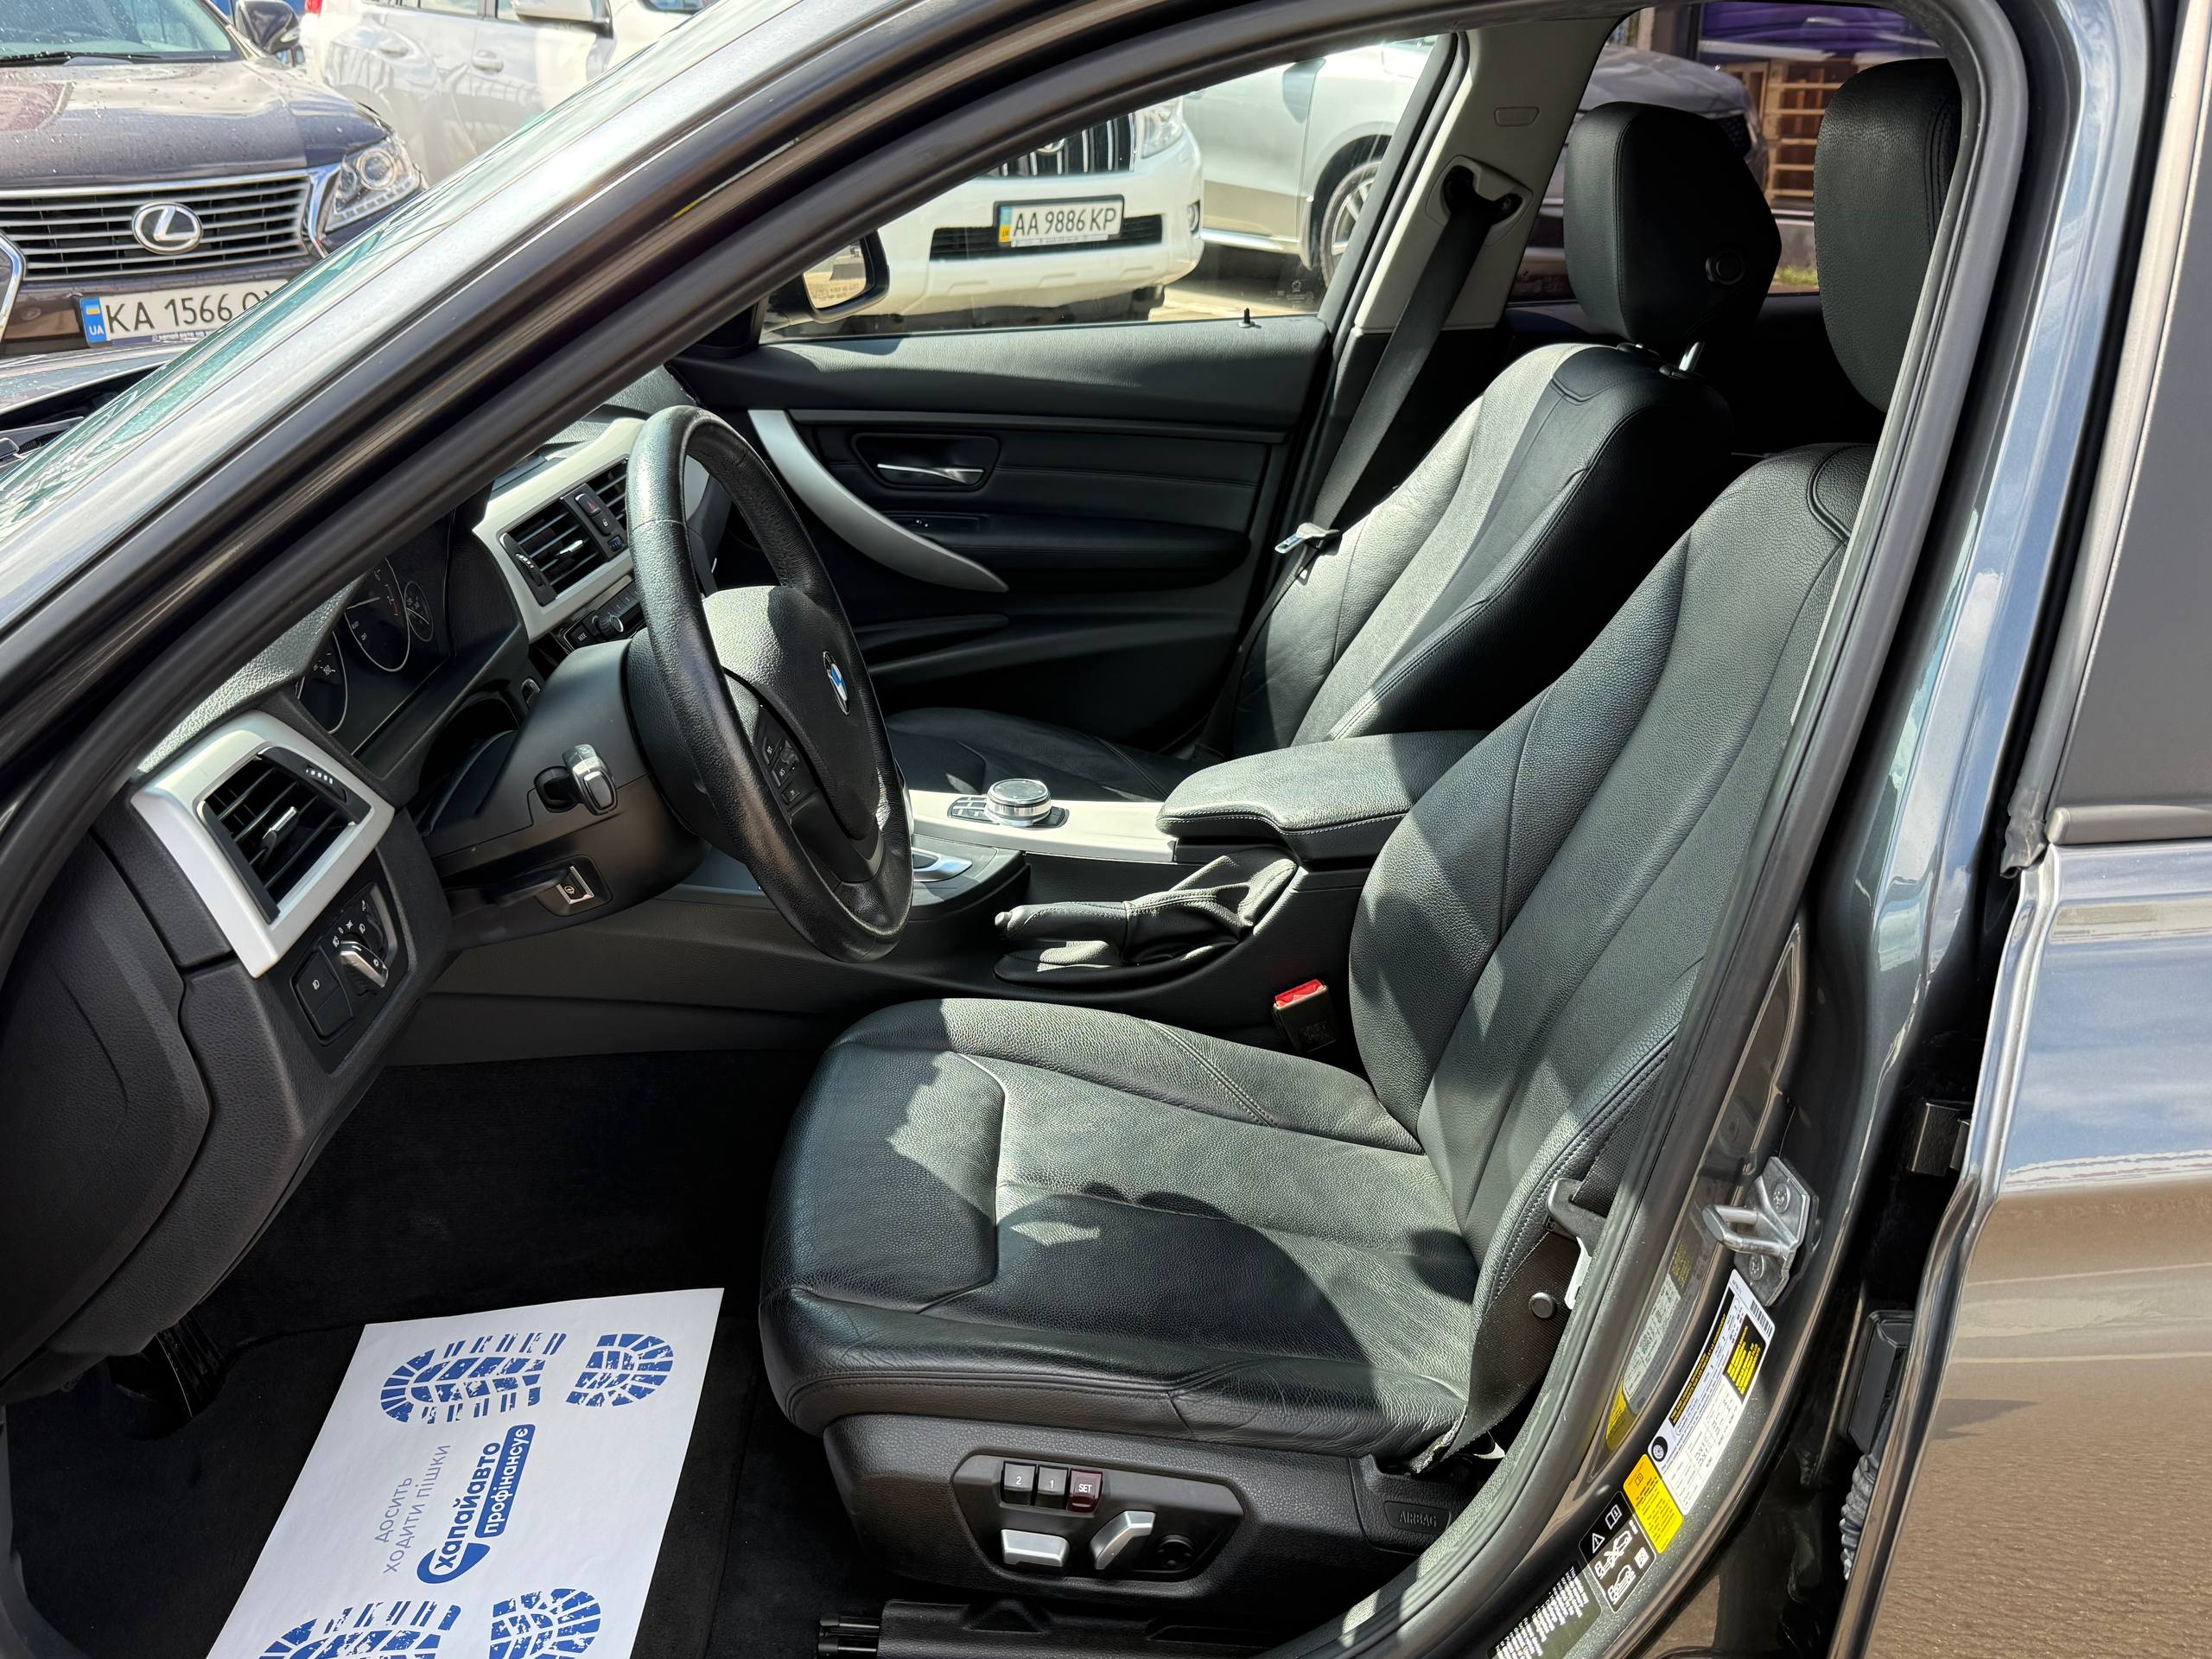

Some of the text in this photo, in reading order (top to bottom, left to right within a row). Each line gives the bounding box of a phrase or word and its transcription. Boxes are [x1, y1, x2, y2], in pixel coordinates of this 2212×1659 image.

[1014, 207, 1116, 237] AA 9886 KP
[105, 302, 156, 334] KA
[163, 294, 232, 327] 1566
[89, 325, 105, 336] UA
[483, 1427, 530, 1534] профінансує
[1015, 1476, 1022, 1485] 2
[1050, 1479, 1054, 1489] 1
[1078, 1484, 1093, 1493] SET
[434, 1442, 501, 1570] хапайавто
[1400, 1510, 1437, 1528] AIRBAG
